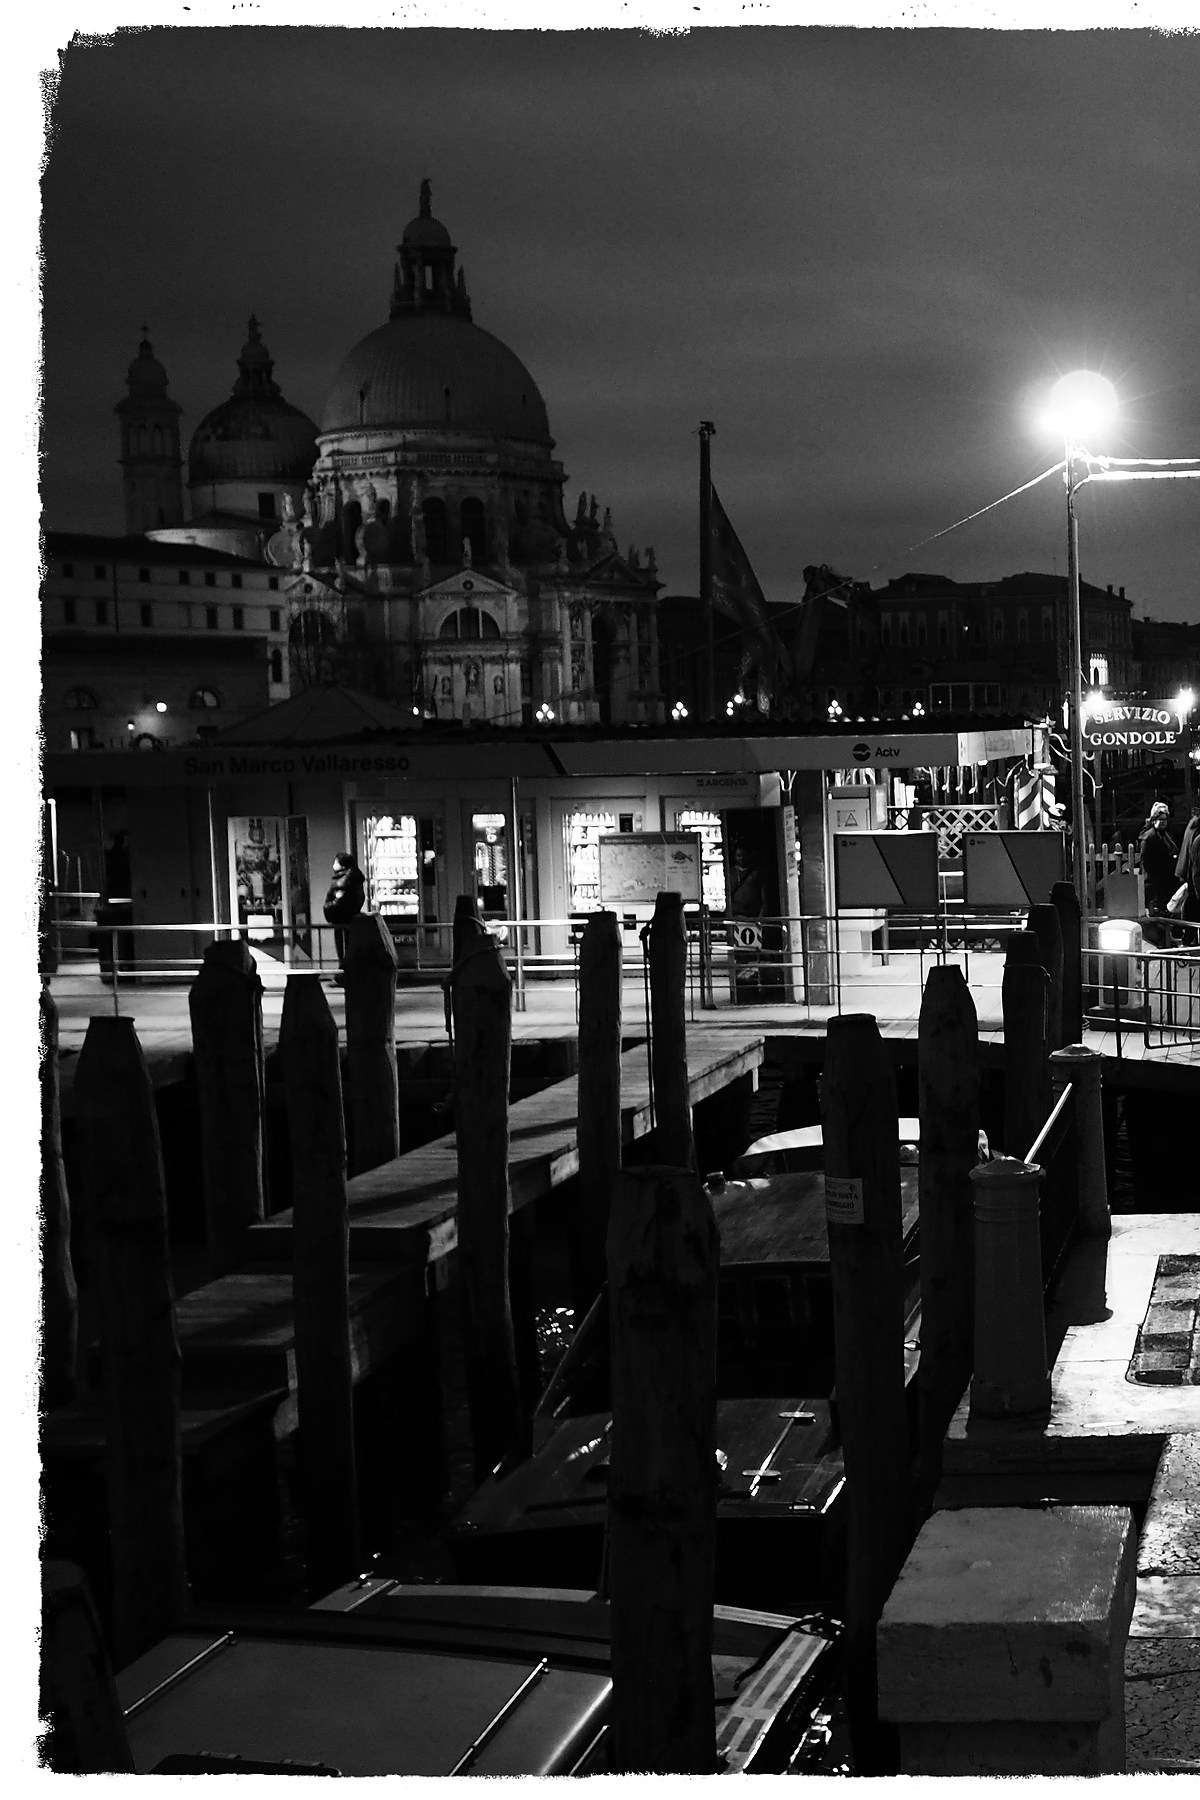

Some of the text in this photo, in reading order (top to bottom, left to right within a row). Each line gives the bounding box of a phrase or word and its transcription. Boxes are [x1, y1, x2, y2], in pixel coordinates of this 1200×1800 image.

[1093, 707, 1170, 724] SERVIZIO
[1090, 732, 1176, 745] GONDOLE
[876, 748, 900, 757] Actv
[185, 754, 410, 774] San Marco Vallaresso
